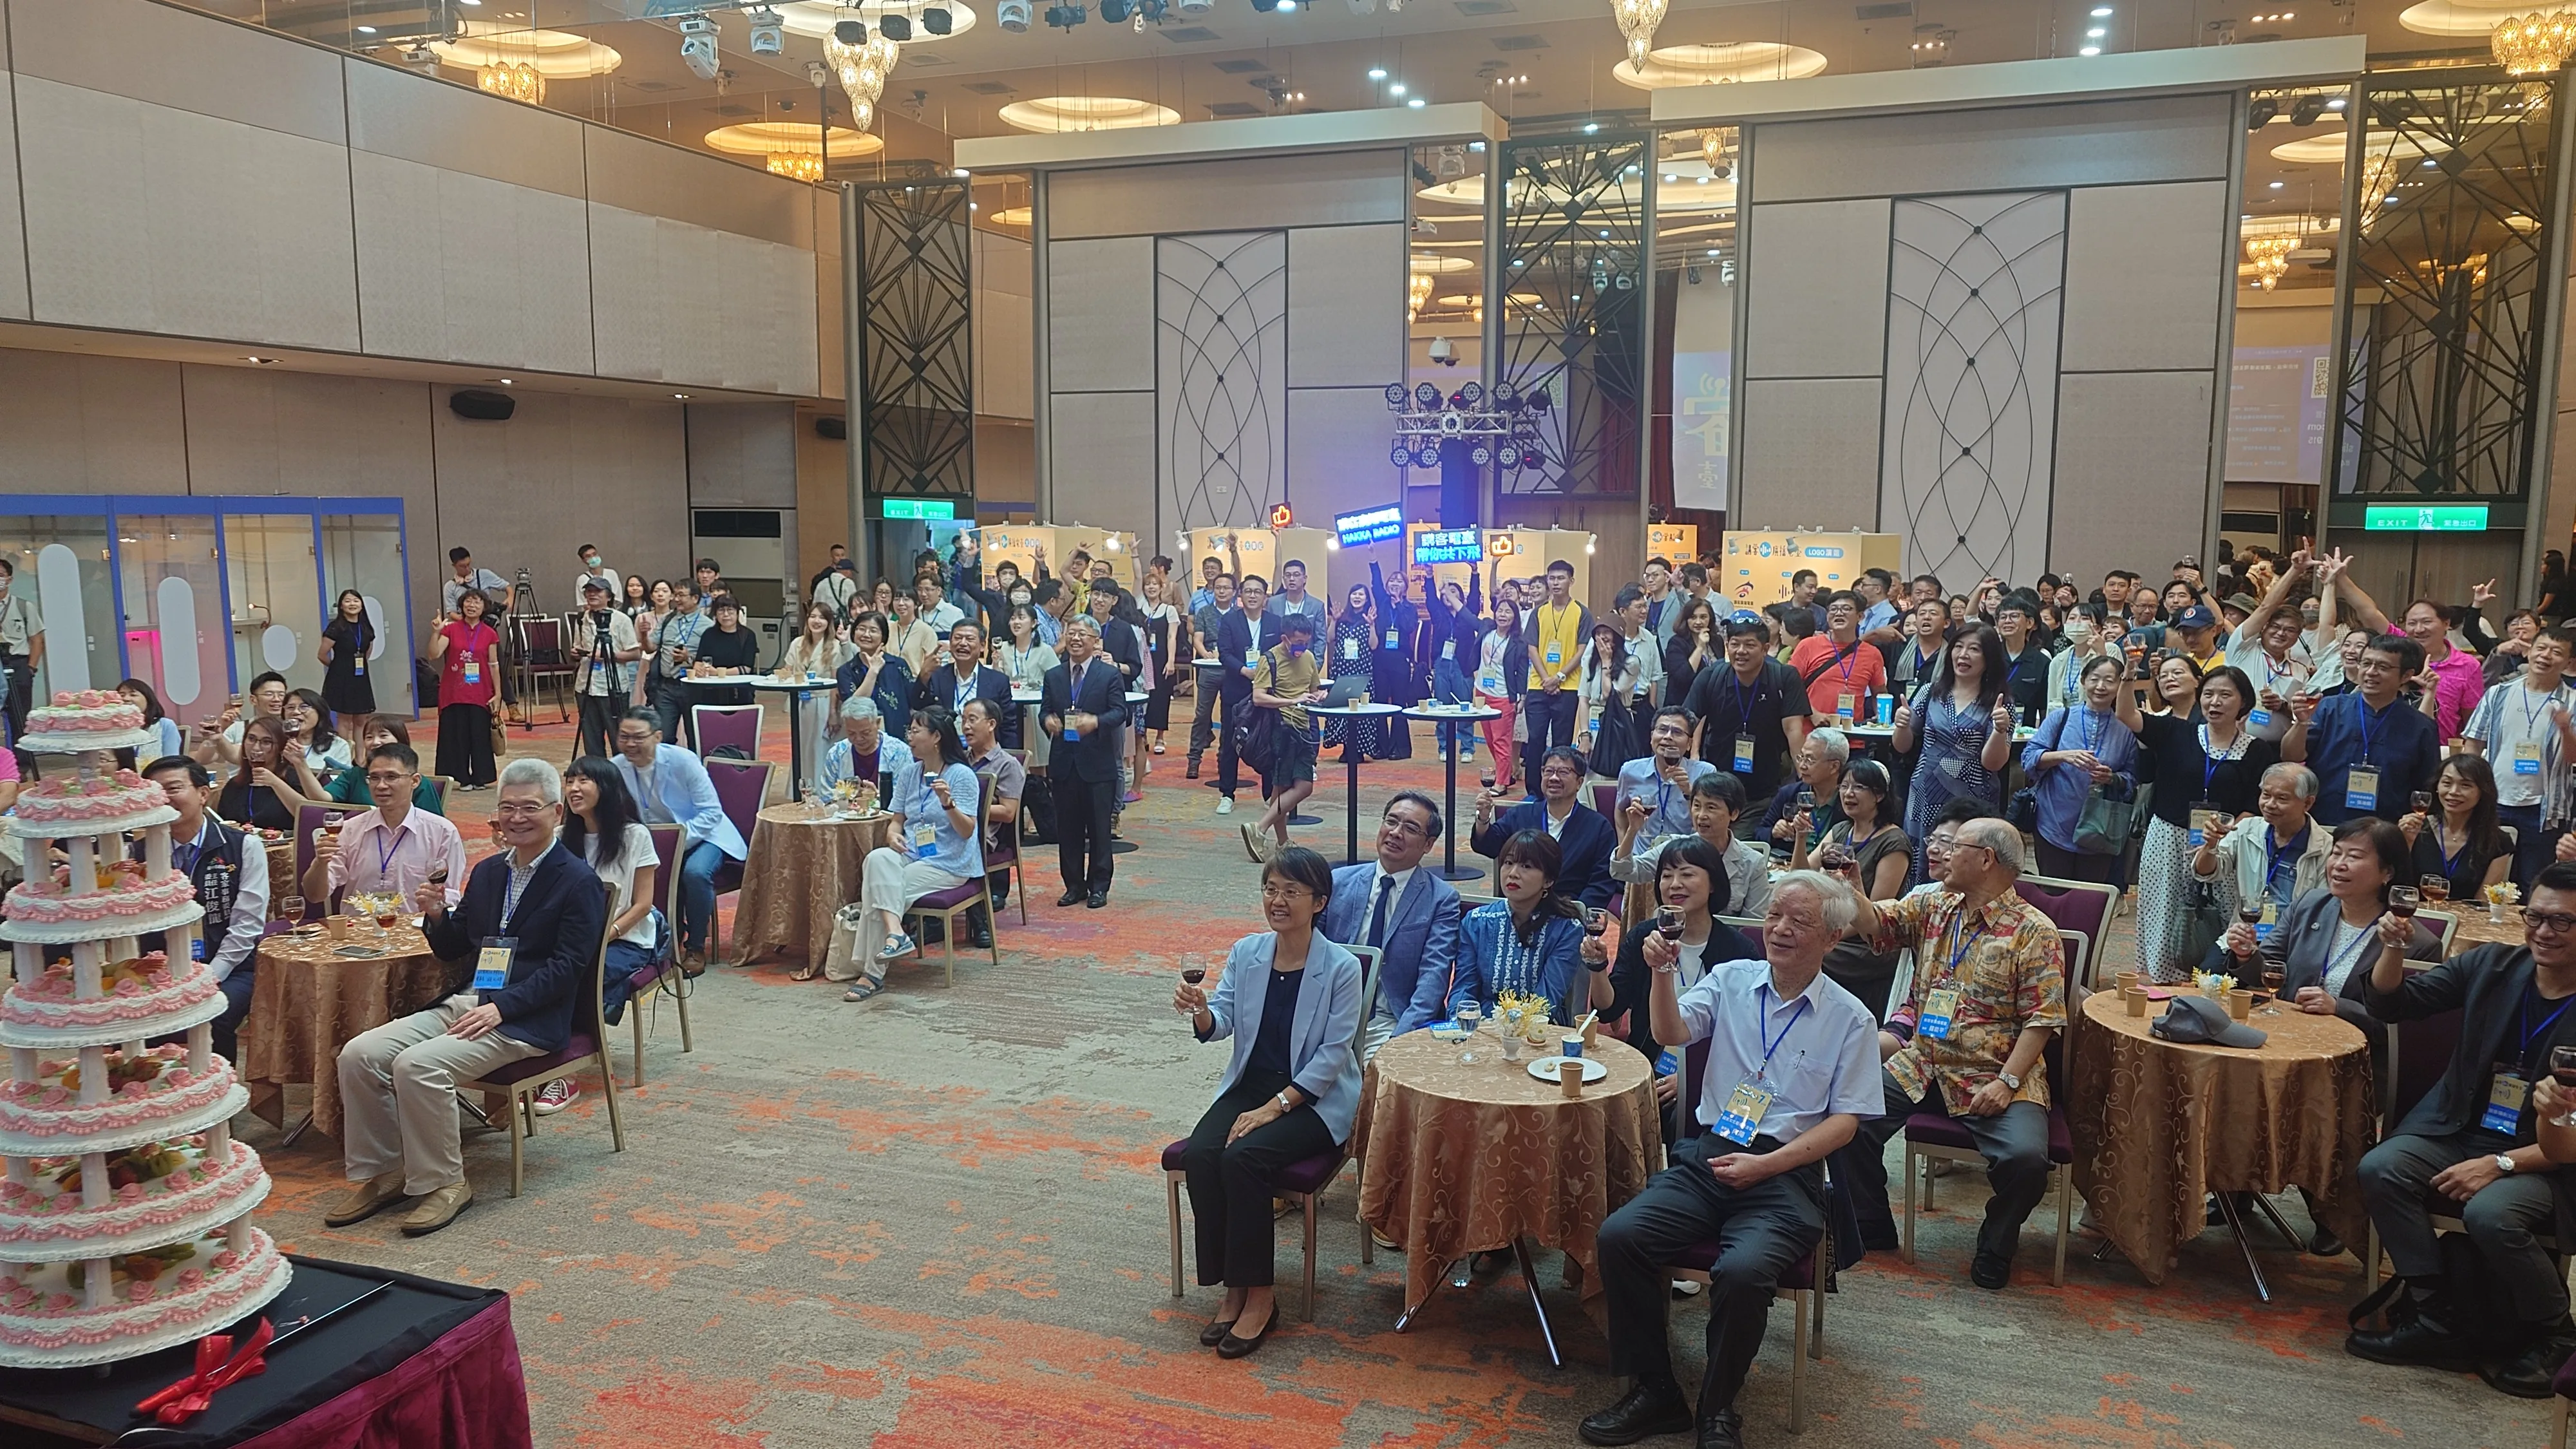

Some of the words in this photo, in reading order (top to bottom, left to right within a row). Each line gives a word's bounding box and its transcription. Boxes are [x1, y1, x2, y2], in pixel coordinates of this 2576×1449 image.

[1342, 529, 1372, 544] HAKKA
[1372, 524, 1400, 538] RADIO
[1947, 994, 1953, 1002] 7
[1757, 1095, 1766, 1104] 7
